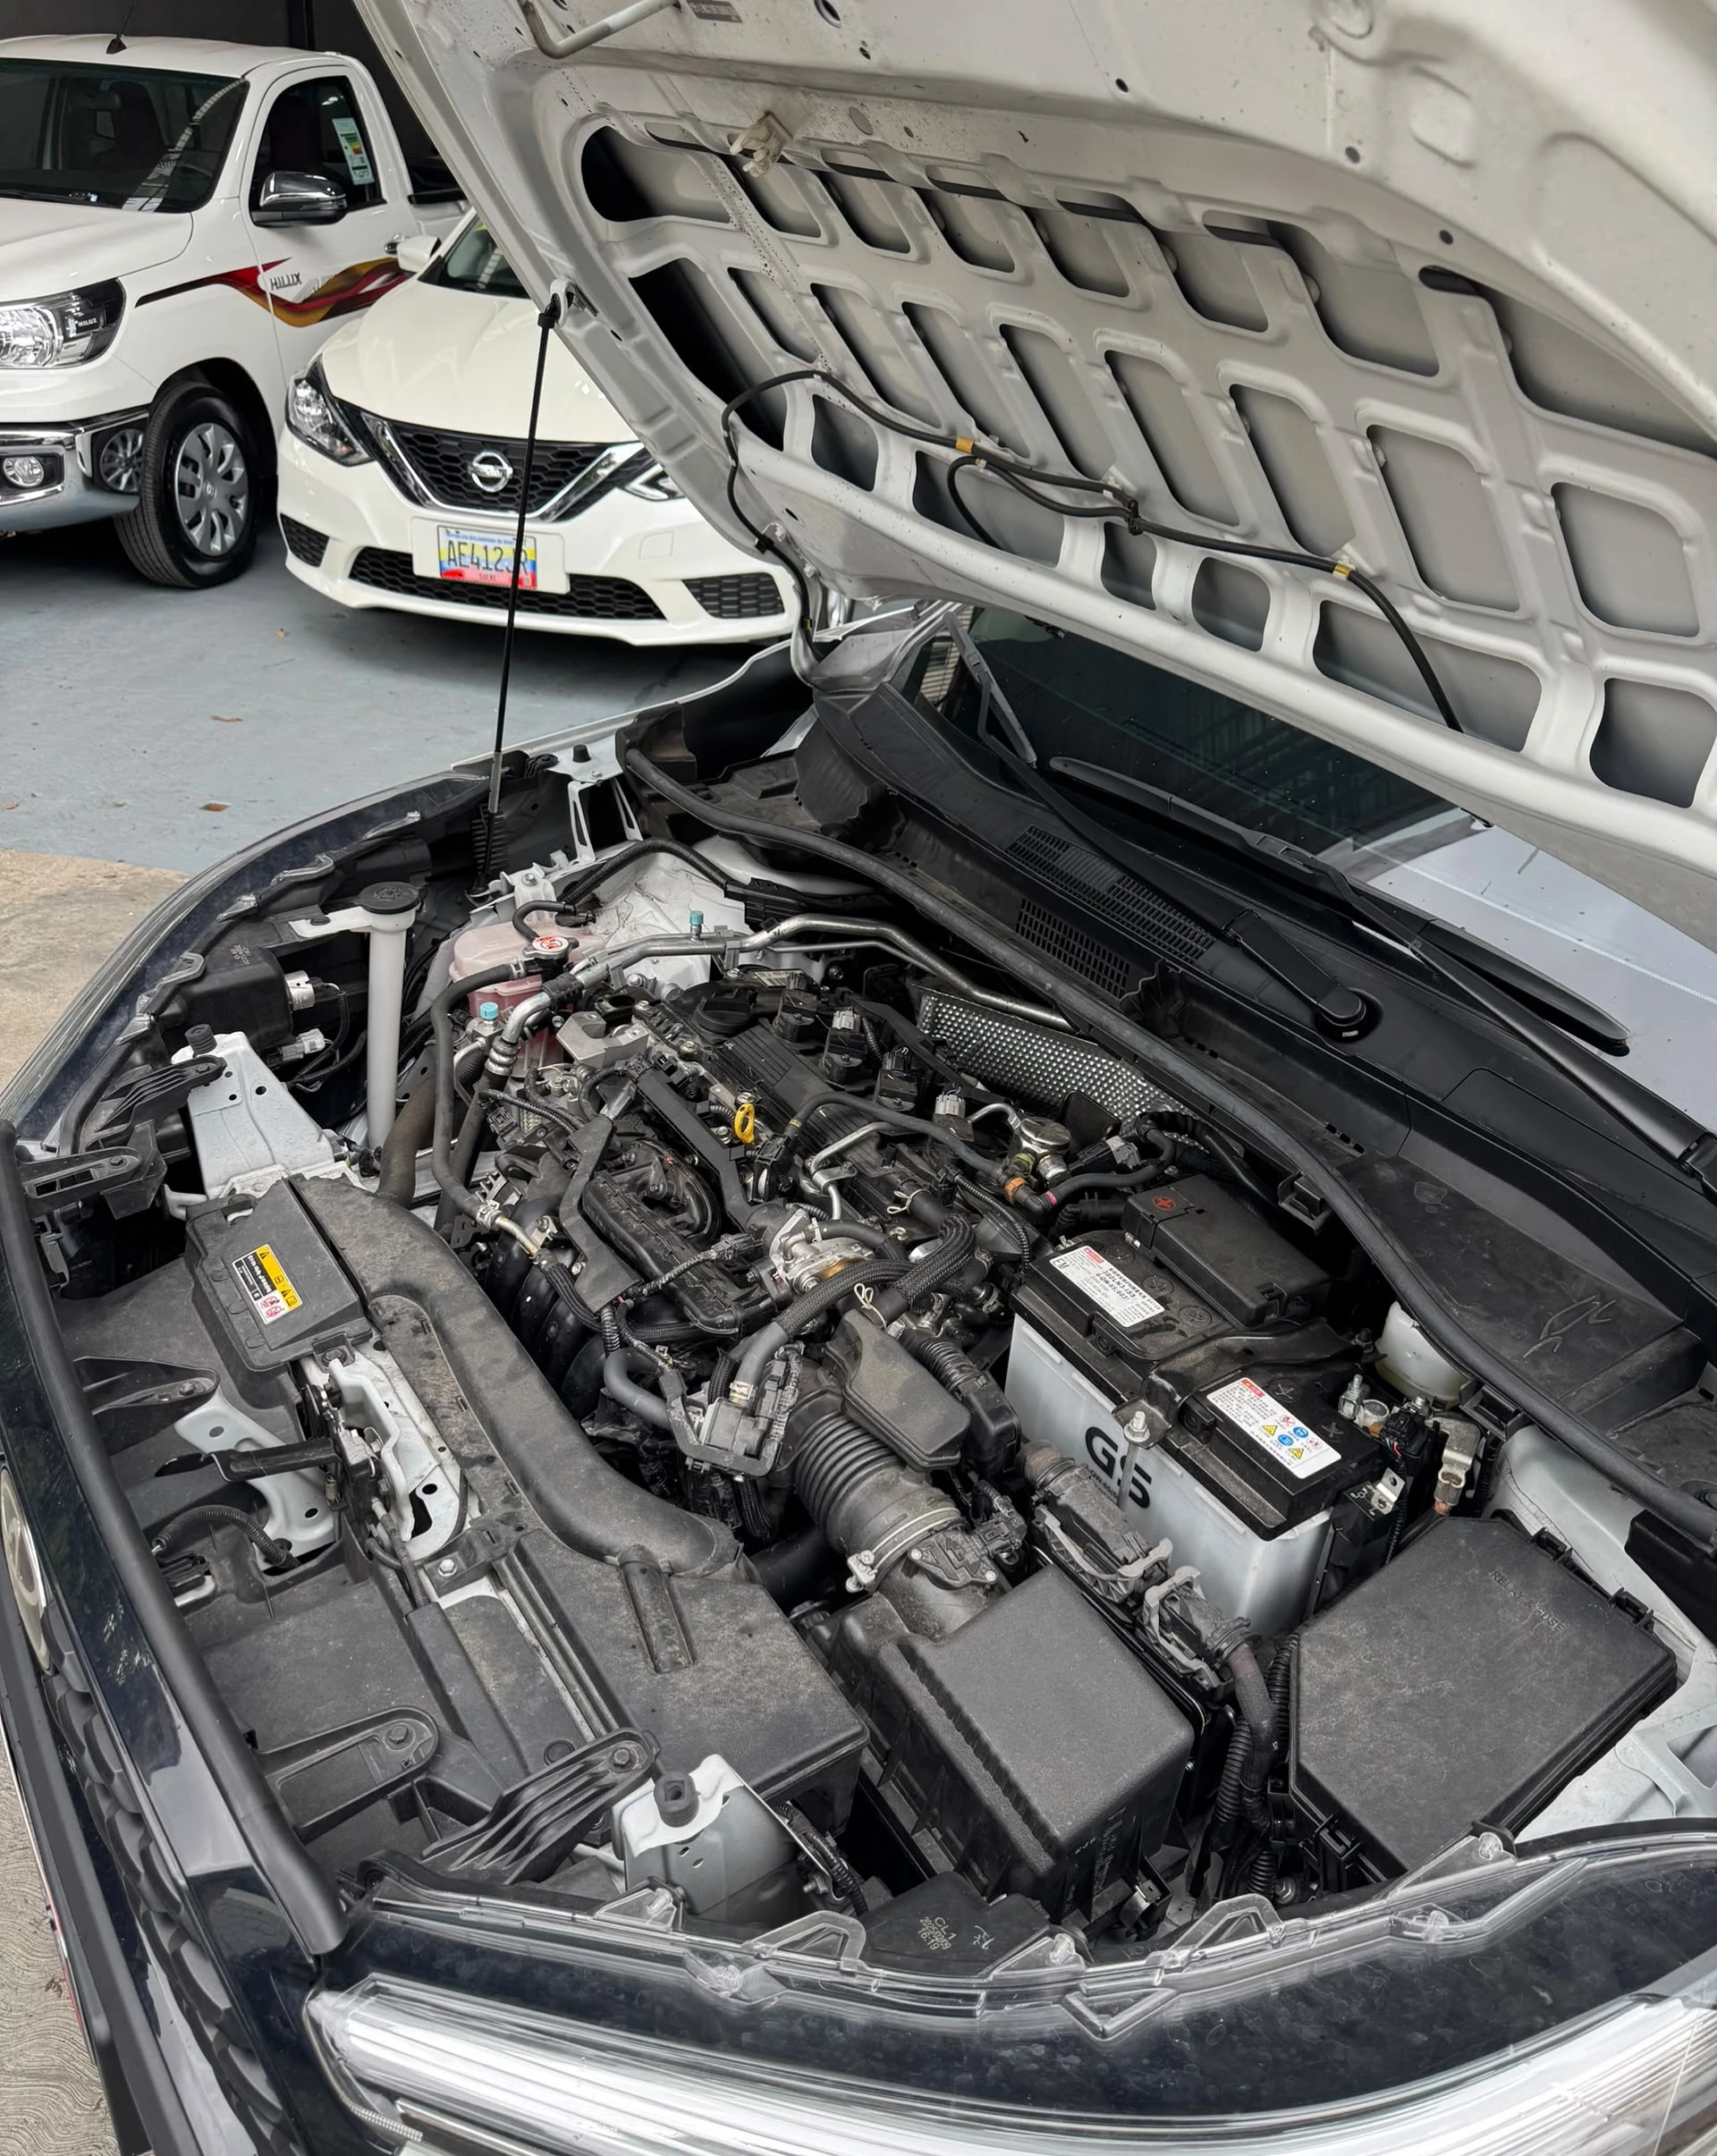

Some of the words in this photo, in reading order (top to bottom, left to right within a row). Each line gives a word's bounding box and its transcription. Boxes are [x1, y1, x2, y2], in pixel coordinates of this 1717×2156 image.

[269, 272, 302, 291] HILUX
[1085, 1426, 1152, 1509] GS
[1490, 1570, 1527, 1599] RELAY
[1537, 1607, 1565, 1632] FUSE
[918, 1928, 940, 1950] 16:19
[919, 1916, 952, 1950] 2025/02/09
[934, 1916, 950, 1935] CL
[948, 1932, 957, 1940] 1
